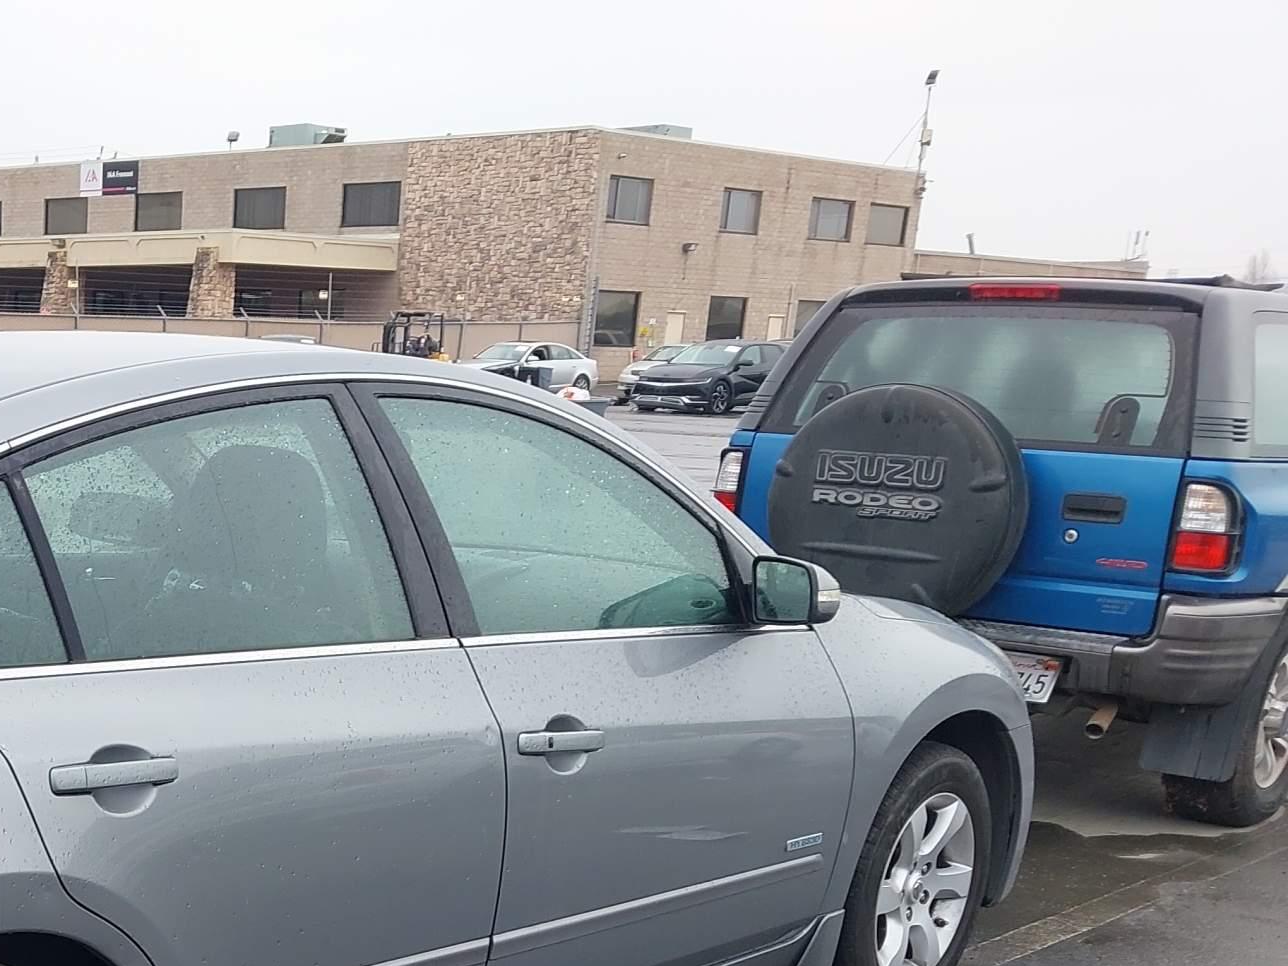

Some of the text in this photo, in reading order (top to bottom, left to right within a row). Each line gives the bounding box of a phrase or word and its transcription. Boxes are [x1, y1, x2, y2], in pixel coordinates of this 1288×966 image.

[815, 450, 948, 488] ISUZU
[812, 486, 942, 511] RODEO
[856, 506, 937, 520] SPORT
